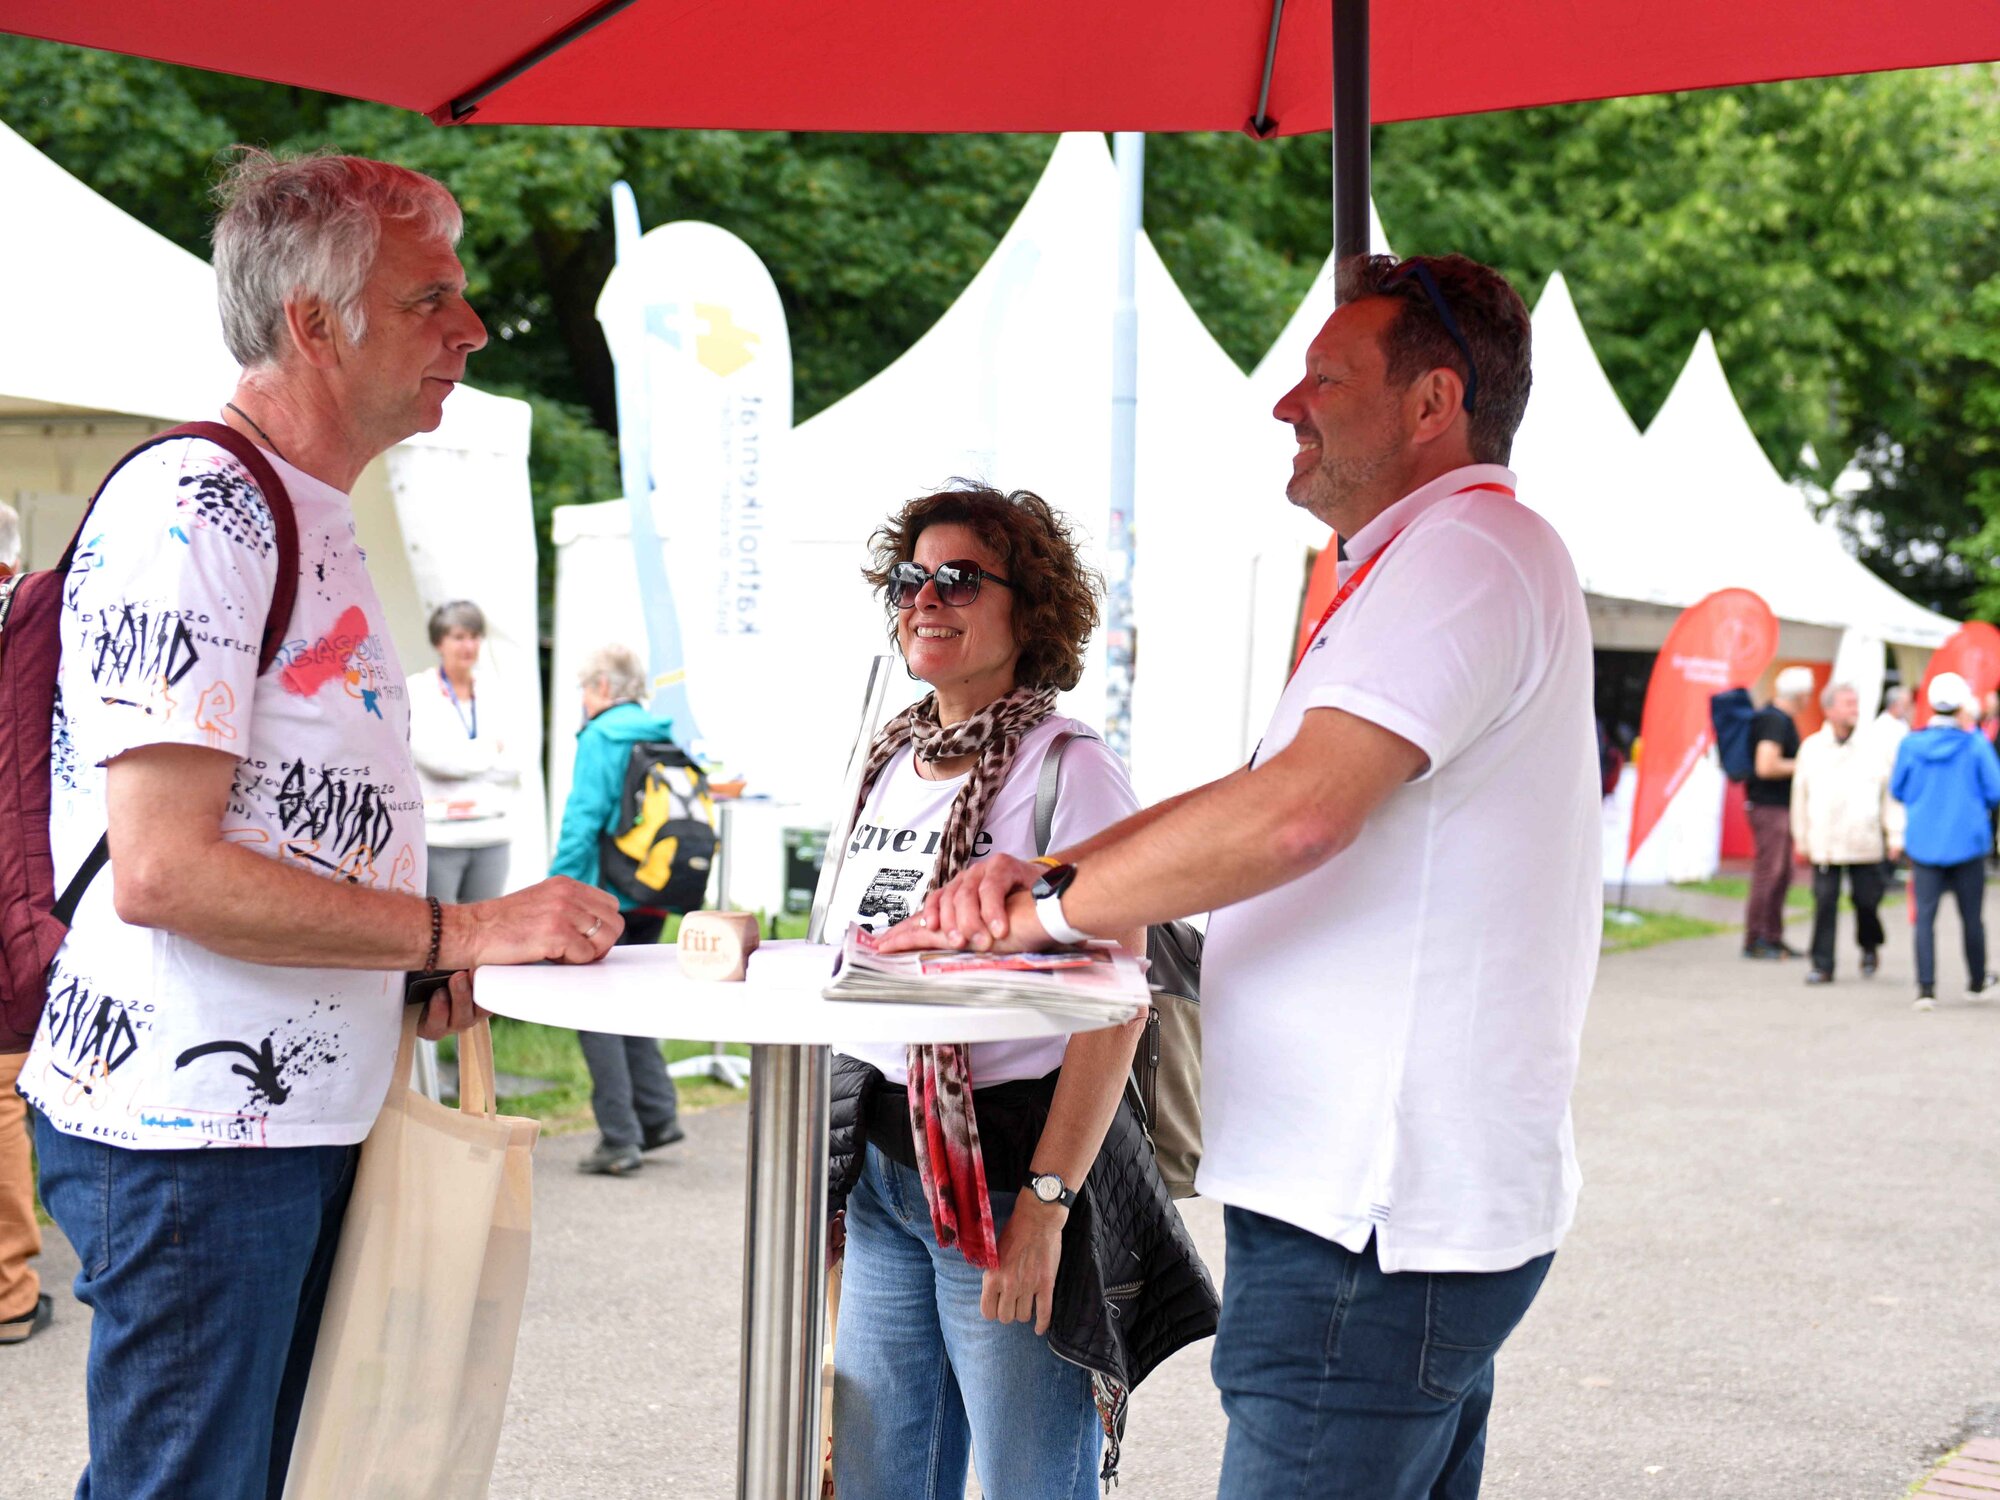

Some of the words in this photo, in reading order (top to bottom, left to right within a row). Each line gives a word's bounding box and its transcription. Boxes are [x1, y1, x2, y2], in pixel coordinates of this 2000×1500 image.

[281, 762, 371, 777] POJECTS
[846, 816, 918, 860] give
[682, 927, 722, 953] für
[201, 1118, 255, 1142] HIGH
